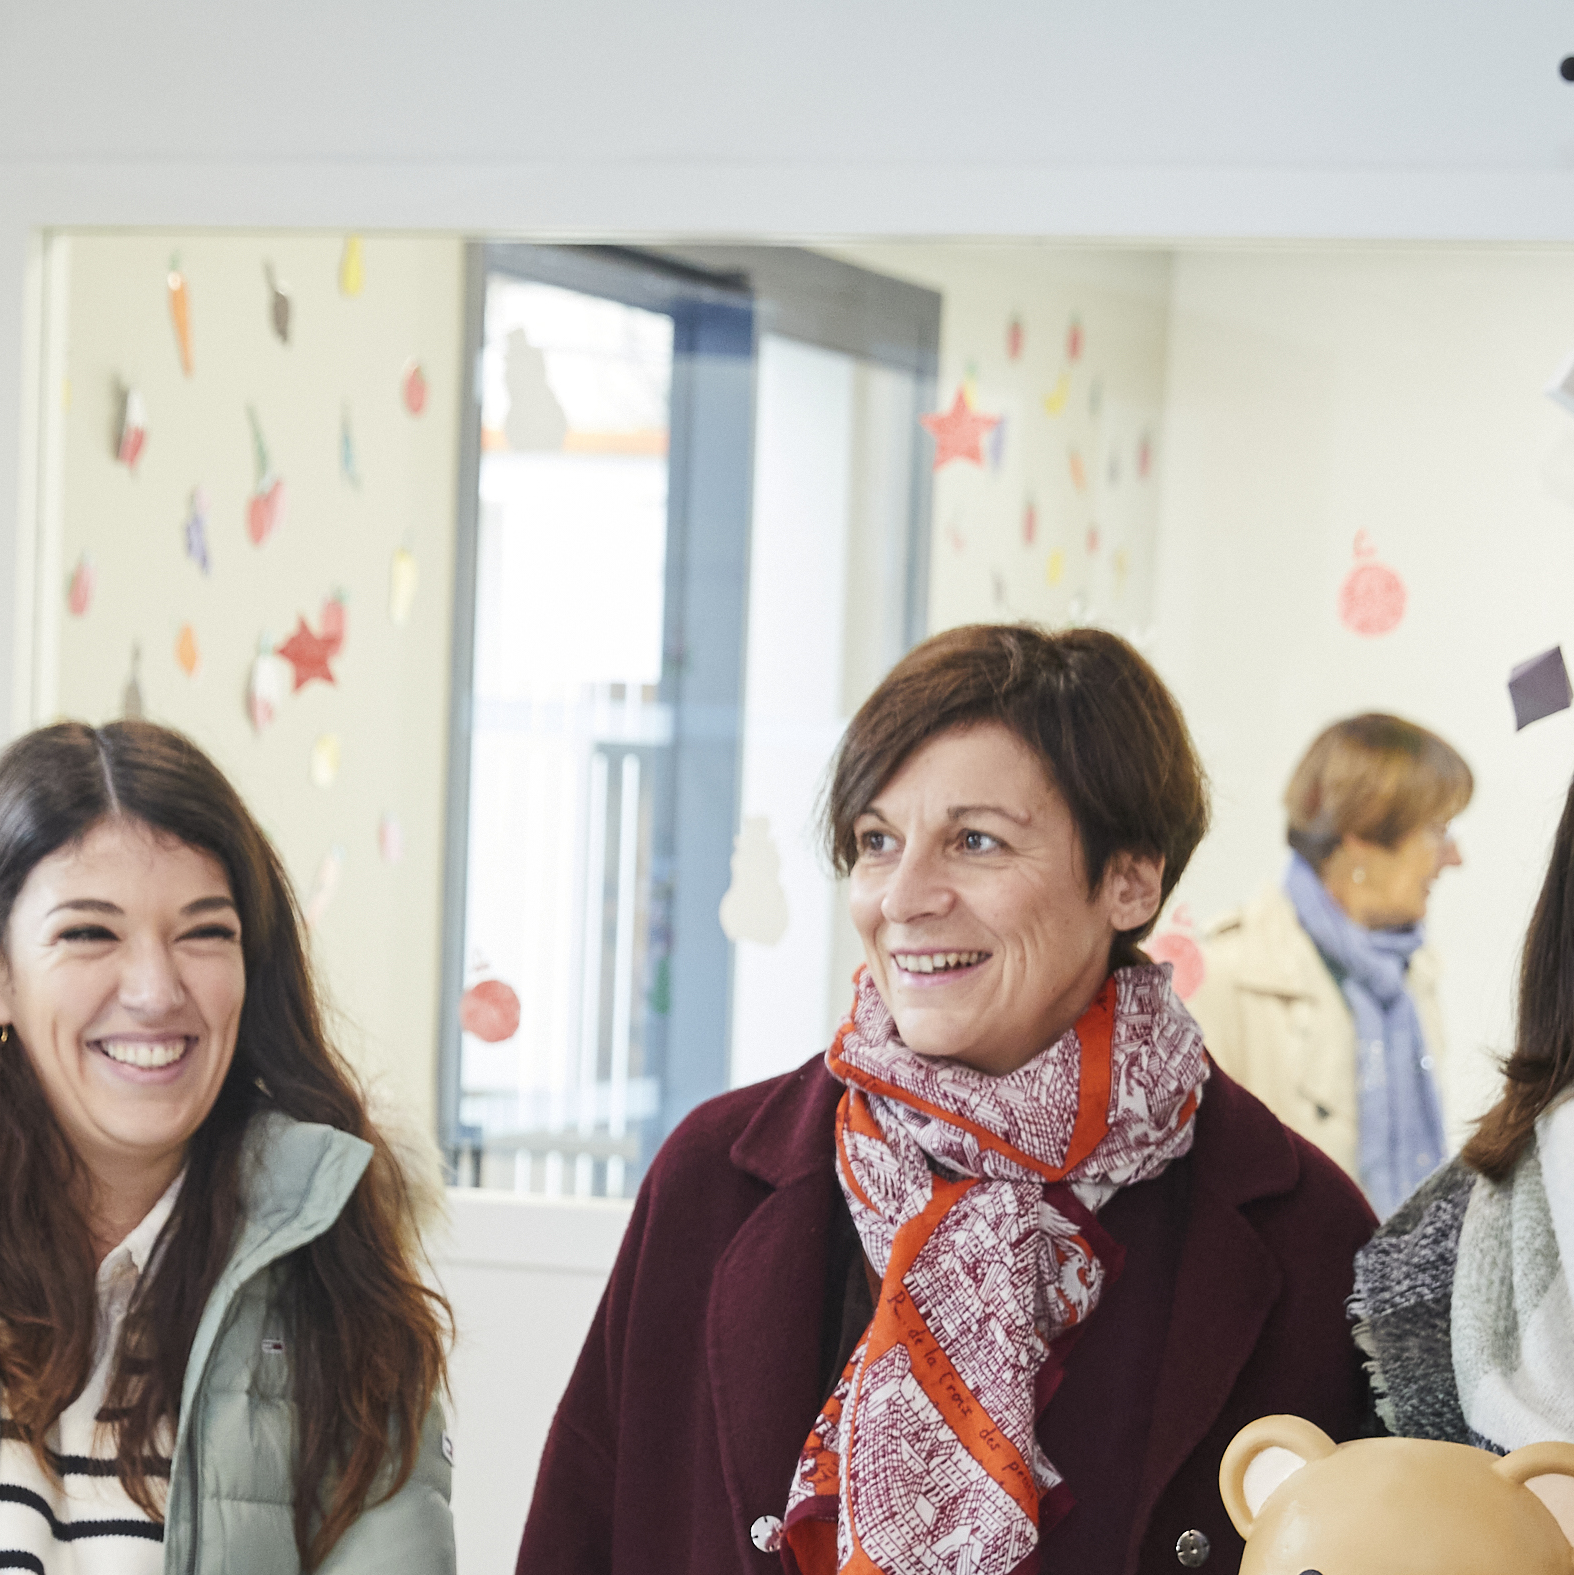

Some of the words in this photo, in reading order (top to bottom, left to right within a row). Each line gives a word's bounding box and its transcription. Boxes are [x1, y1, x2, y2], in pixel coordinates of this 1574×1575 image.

[908, 1329, 929, 1345] de
[924, 1347, 941, 1367] la
[979, 1428, 1001, 1451] des
